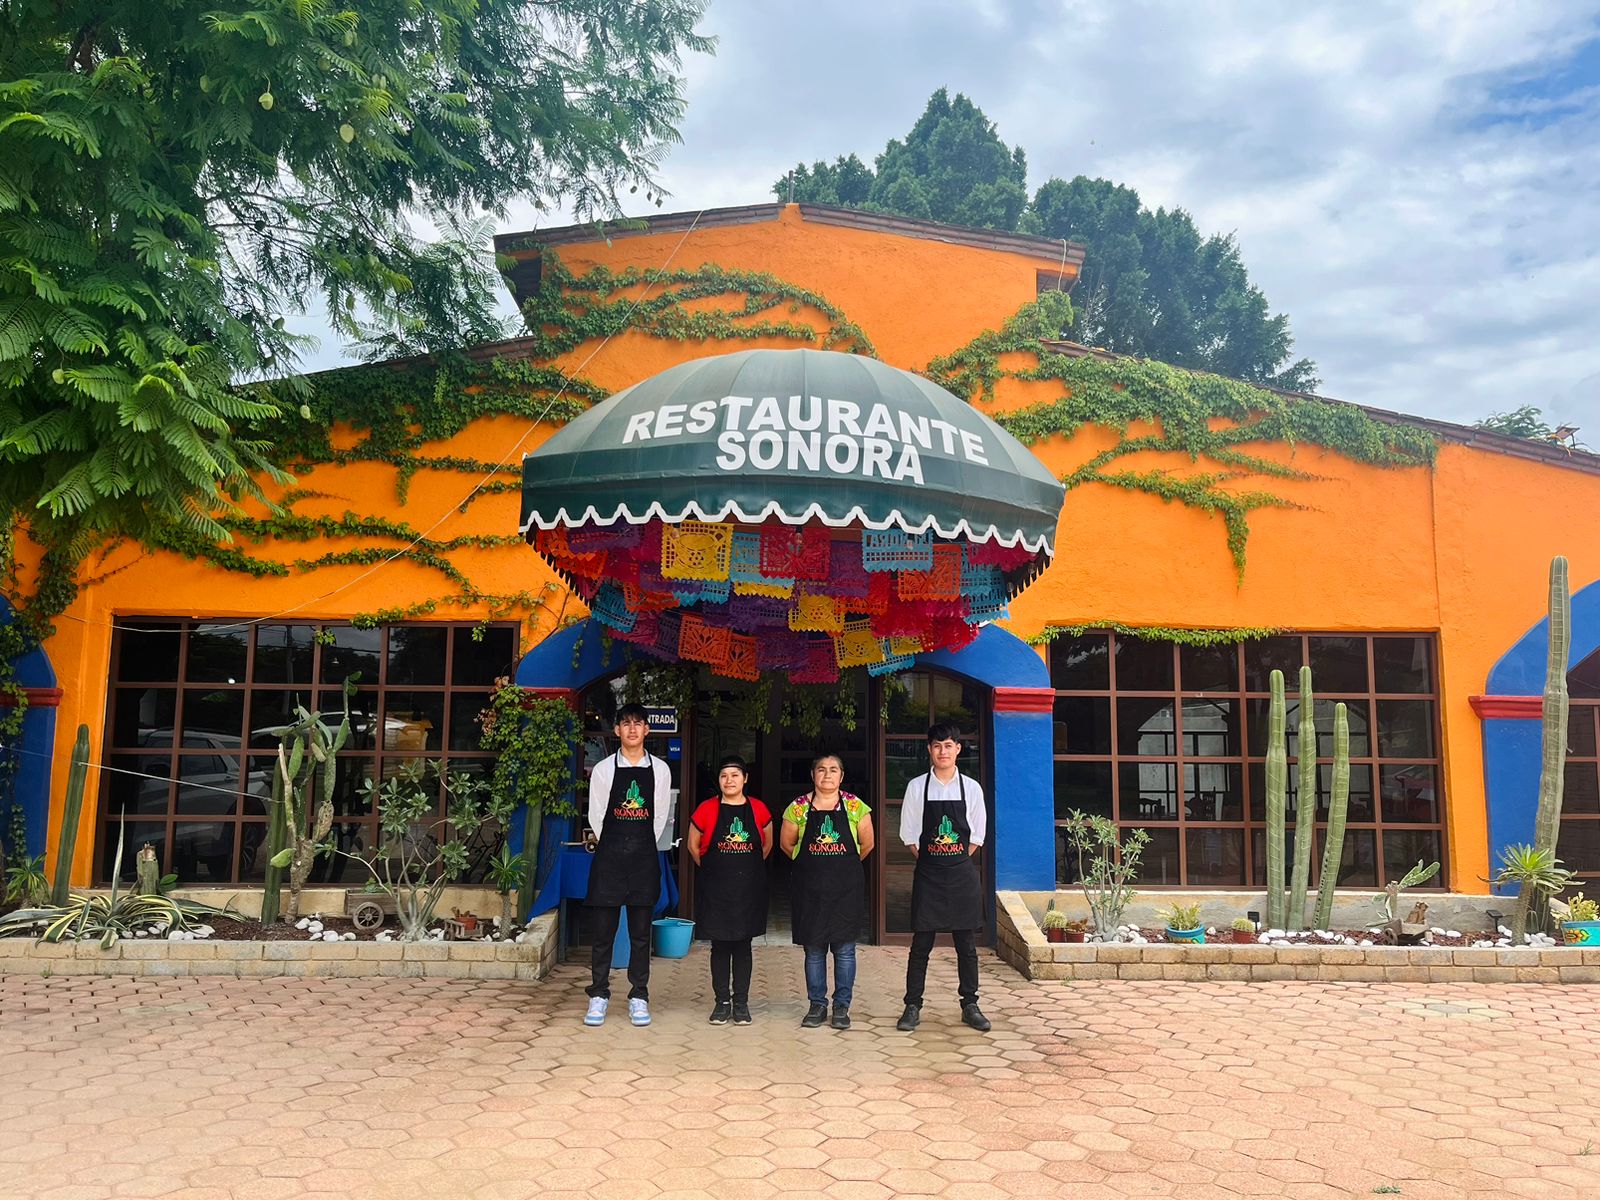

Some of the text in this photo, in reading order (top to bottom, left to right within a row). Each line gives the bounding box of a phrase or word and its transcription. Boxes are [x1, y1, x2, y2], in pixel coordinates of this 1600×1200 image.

[622, 395, 990, 466] RESTAURANTE
[715, 430, 926, 485] SONORA
[647, 715, 675, 724] NTRADA
[613, 808, 650, 817] SONORA
[717, 841, 753, 850] SONORA
[808, 843, 847, 852] SONORA
[927, 842, 964, 852] SONORA
